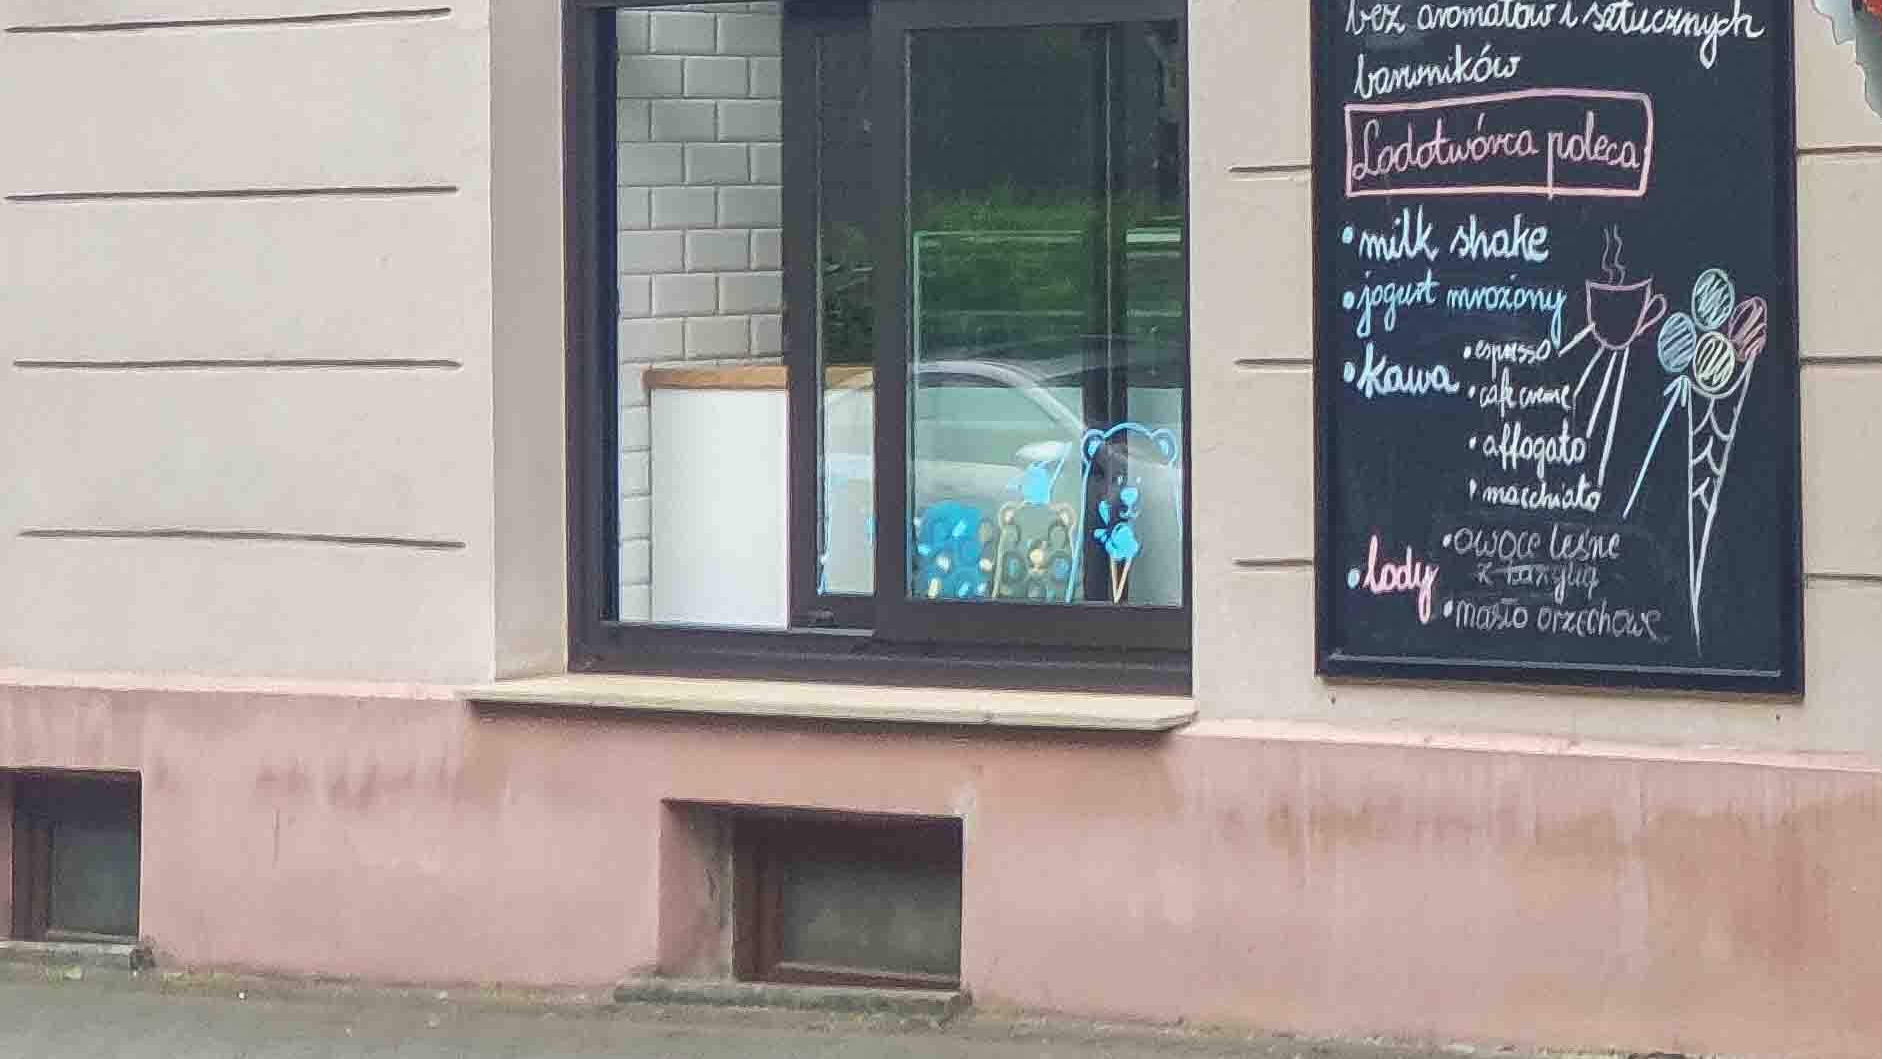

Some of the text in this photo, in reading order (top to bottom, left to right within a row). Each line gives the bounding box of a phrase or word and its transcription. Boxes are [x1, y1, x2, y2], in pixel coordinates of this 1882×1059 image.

[1354, 41, 1521, 99] barwników
[1352, 110, 1640, 199] Lodotwórca poleca
[1359, 205, 1550, 262] milk shake
[1354, 268, 1567, 348] jogurt mrożony
[1482, 417, 1586, 480] affogato
[1482, 473, 1601, 513] macchiato
[1453, 527, 1542, 559] owoce
[1537, 599, 1668, 640] orzechowe
